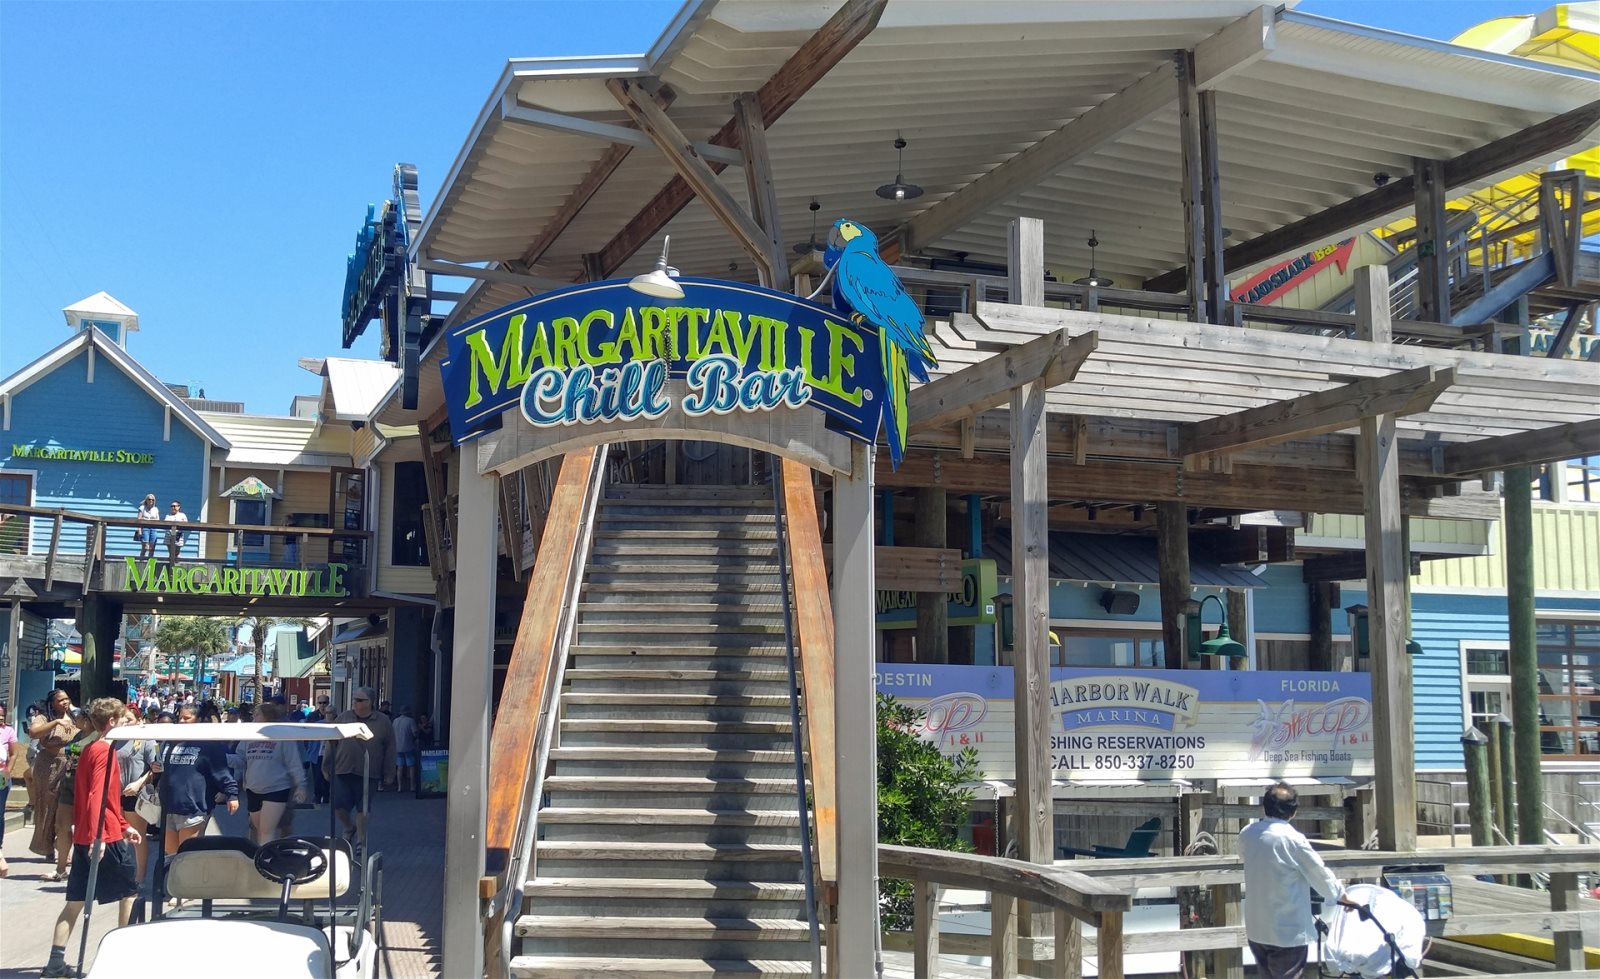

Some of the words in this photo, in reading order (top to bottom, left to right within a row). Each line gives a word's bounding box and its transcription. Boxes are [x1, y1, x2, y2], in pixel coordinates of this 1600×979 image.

[465, 306, 863, 410] MARGARITAVILLE
[520, 358, 671, 428] Chill
[682, 353, 812, 418] Bar
[12, 444, 114, 463] MARGARITAVILLE
[116, 449, 154, 465] STORE
[124, 556, 349, 597] MARGARITAVILLE
[876, 673, 932, 686] DESTIN
[1281, 680, 1340, 692] FLORIDA
[1050, 683, 1129, 707] HARBOR
[1132, 681, 1191, 711] WALK
[1076, 710, 1161, 725] MARINA
[1050, 736, 1093, 750] SHING
[1098, 736, 1205, 750] RESERVATIONS
[1051, 755, 1090, 770] CALL
[1095, 754, 1195, 770] 850-337-8250
[1264, 750, 1282, 763] Deep
[1284, 750, 1299, 762] Sea
[1301, 750, 1328, 763] Fishing
[1330, 750, 1352, 762] Boats
